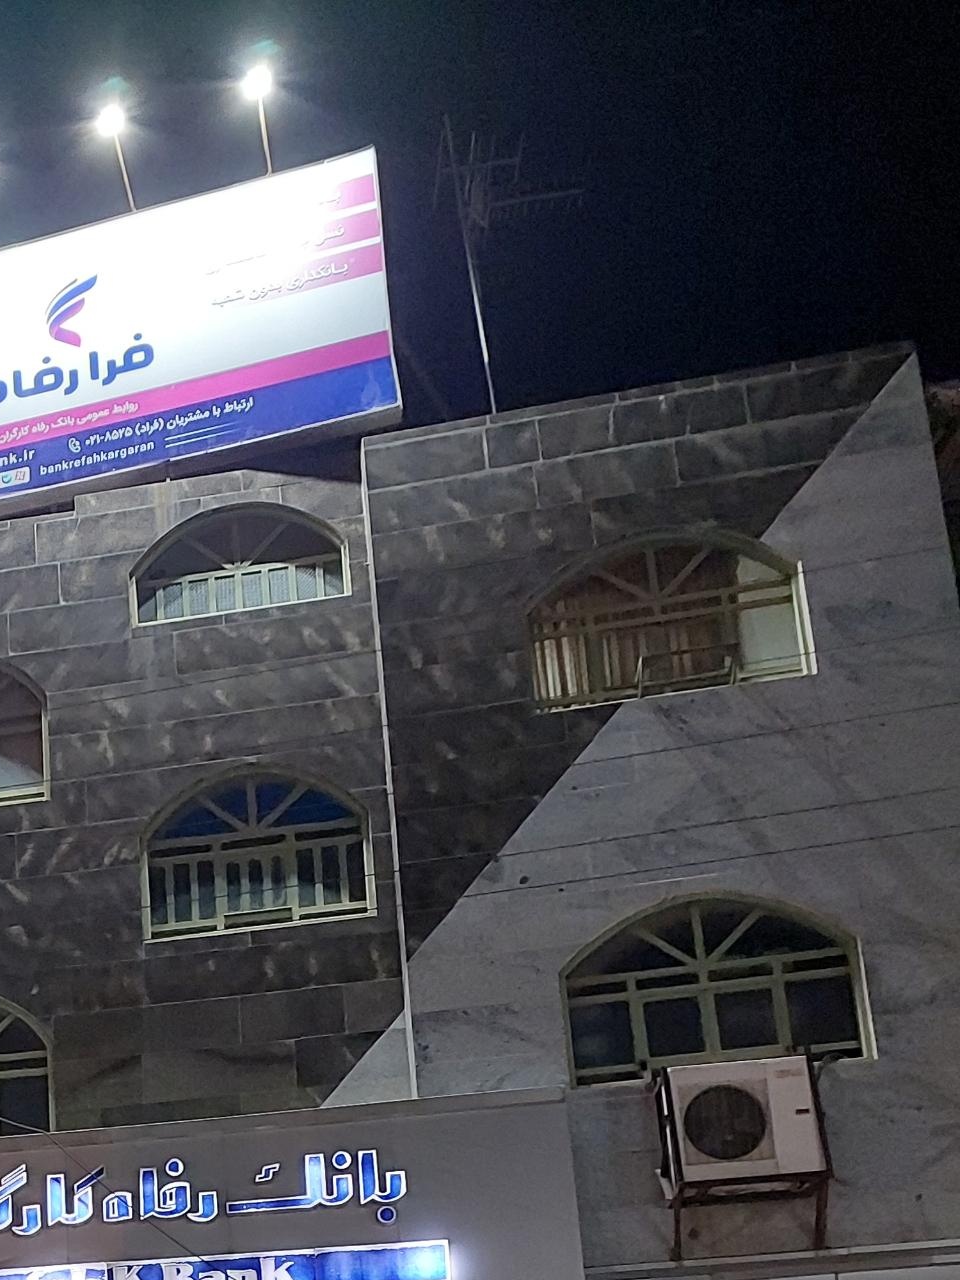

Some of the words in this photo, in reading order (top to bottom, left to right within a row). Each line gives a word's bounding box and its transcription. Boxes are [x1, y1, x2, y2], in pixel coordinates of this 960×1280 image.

[111, 400, 139, 414] روابط
[212, 404, 221, 418] با
[223, 396, 254, 415] ارتباط
[50, 415, 75, 430] بانک
[76, 407, 110, 425] عمومی
[166, 409, 210, 431] مشتریان
[31, 420, 50, 434] رفاه
[39, 441, 155, 477] bankrefahkargaran
[102, 1157, 219, 1223] رفاه
